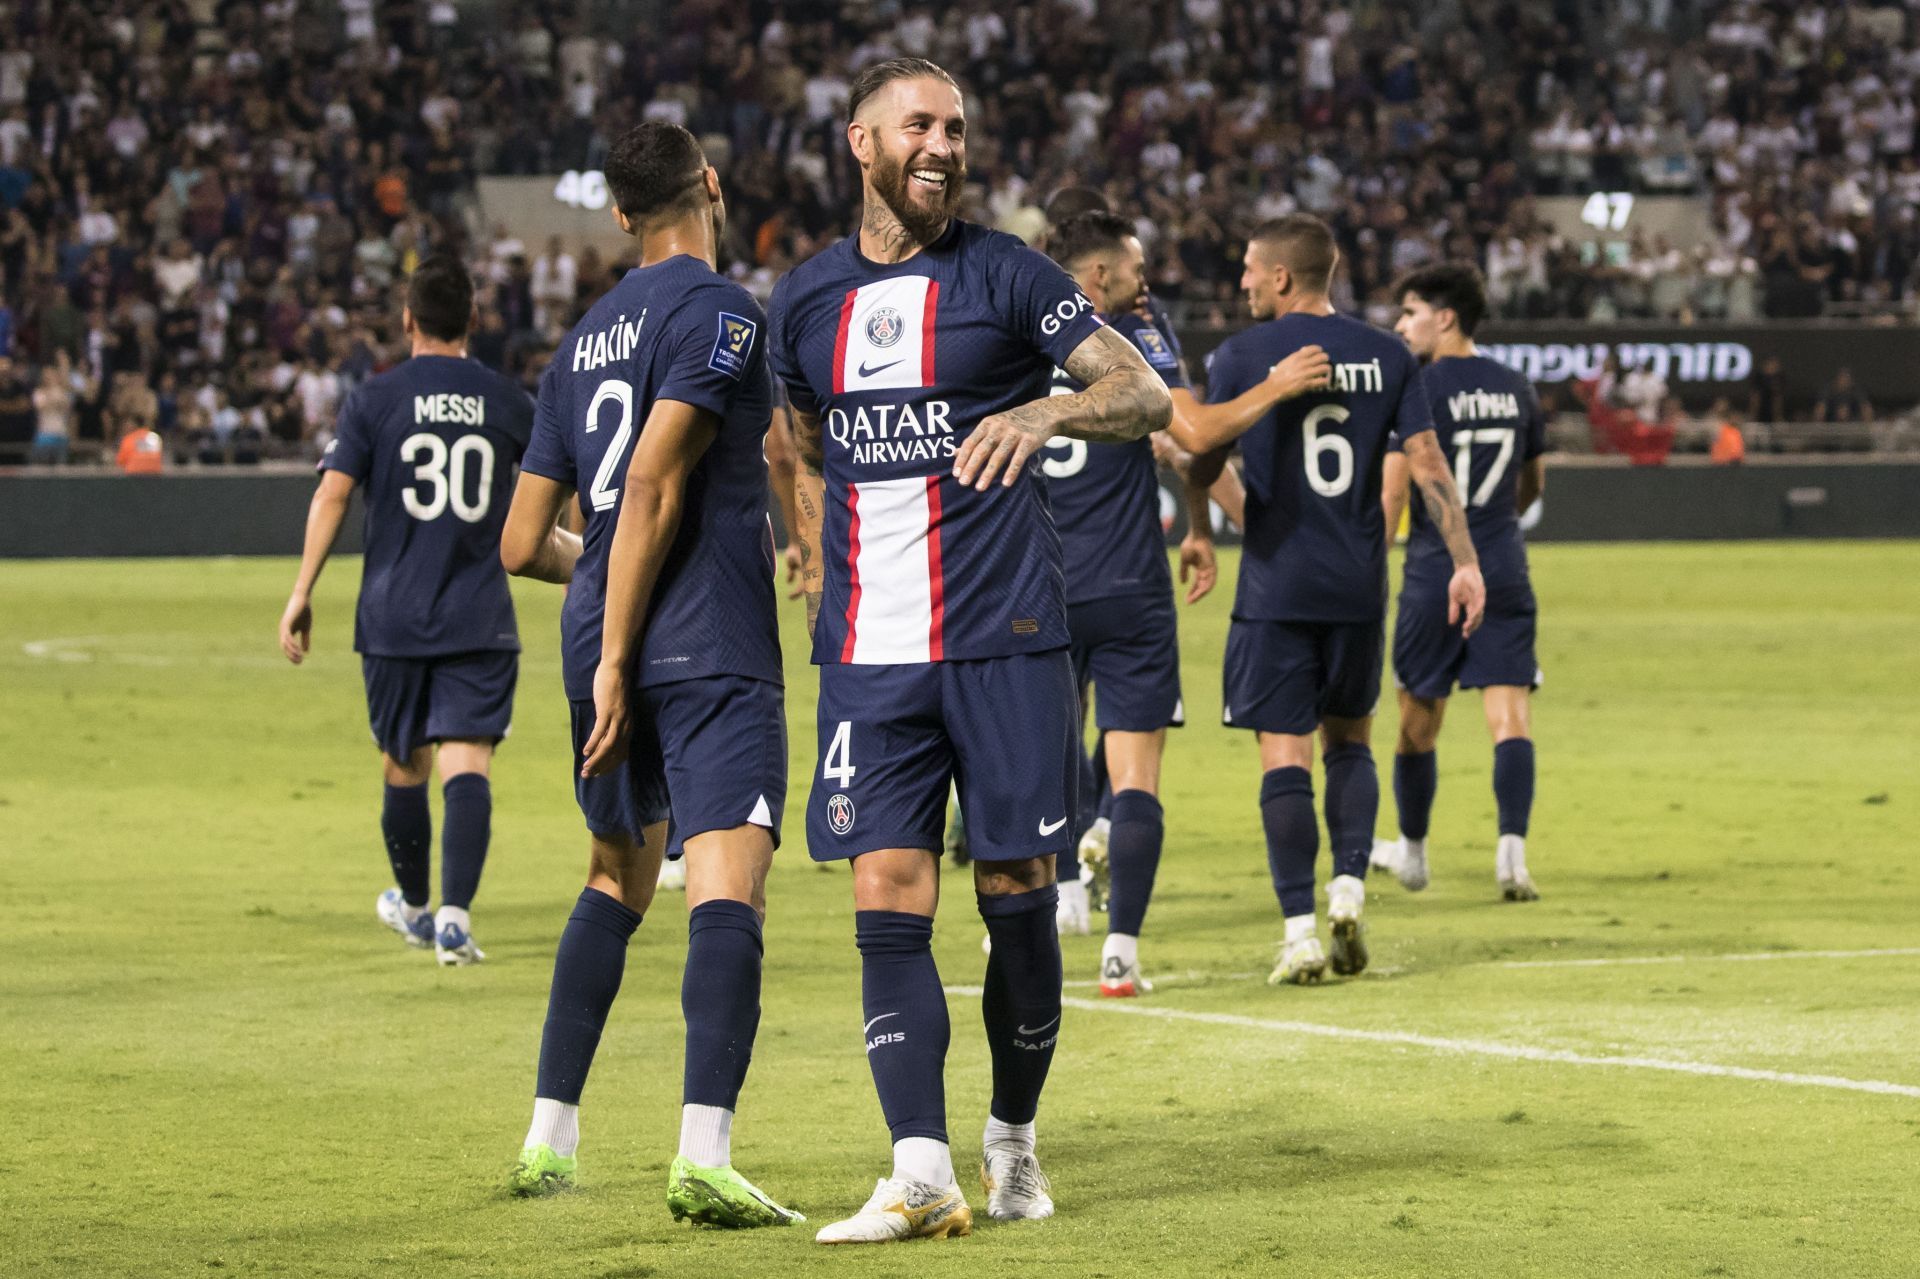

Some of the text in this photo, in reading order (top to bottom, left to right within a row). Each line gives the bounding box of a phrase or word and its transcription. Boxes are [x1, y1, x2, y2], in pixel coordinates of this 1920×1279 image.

[1581, 191, 1634, 231] 47
[1041, 292, 1094, 335] GOA
[414, 393, 485, 427] MESSI
[828, 400, 954, 450] QATAR
[586, 379, 633, 513] 2
[852, 435, 959, 465] AIRWAYS
[1302, 403, 1355, 498] 6
[1451, 427, 1516, 509] 17
[400, 432, 495, 524] 30
[823, 720, 857, 789] 4
